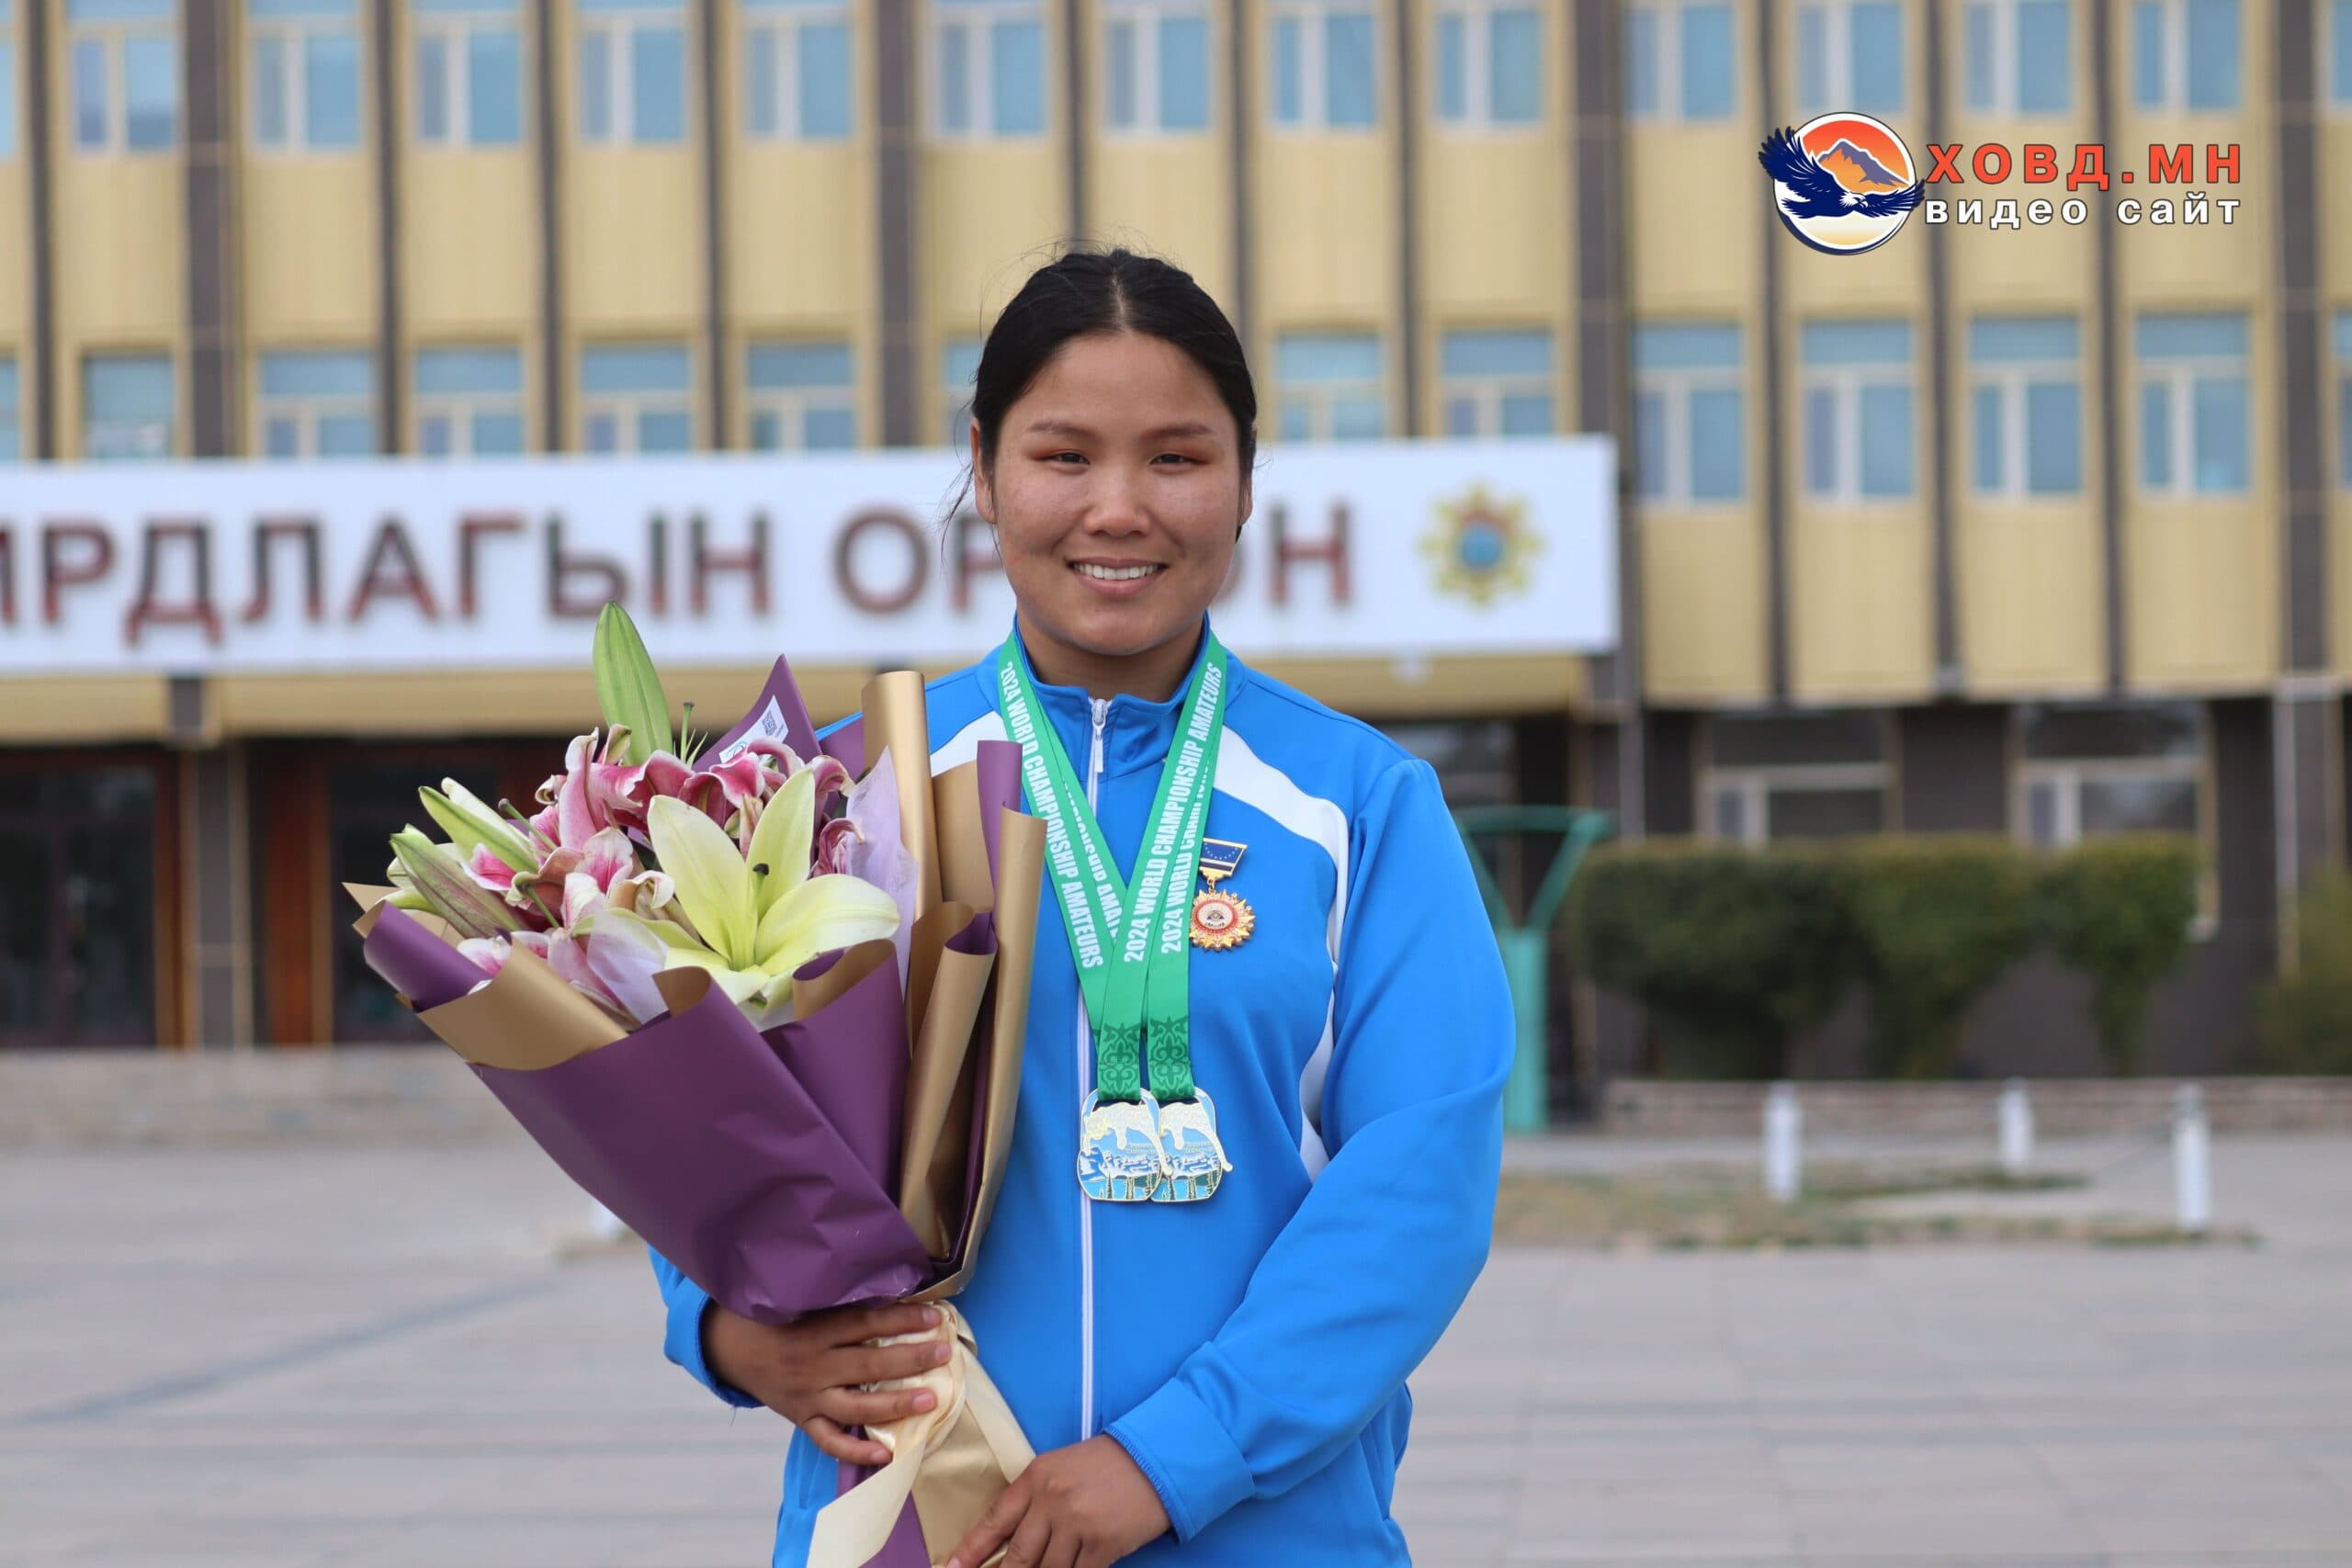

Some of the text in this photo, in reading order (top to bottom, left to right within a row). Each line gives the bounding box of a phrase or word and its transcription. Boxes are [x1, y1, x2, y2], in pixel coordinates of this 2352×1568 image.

[834, 498, 1354, 612] ОРН
[1188, 661, 1222, 742] AMATEURS
[1001, 661, 1103, 968] 2024 WORLD CHAMPIONSHIP AMATEURS
[1152, 741, 1204, 855] CHAMPIONSHIP
[1134, 853, 1170, 917] WORLD
[1161, 852, 1193, 955] 2024 WORLD
[1124, 913, 1151, 963] 2024
